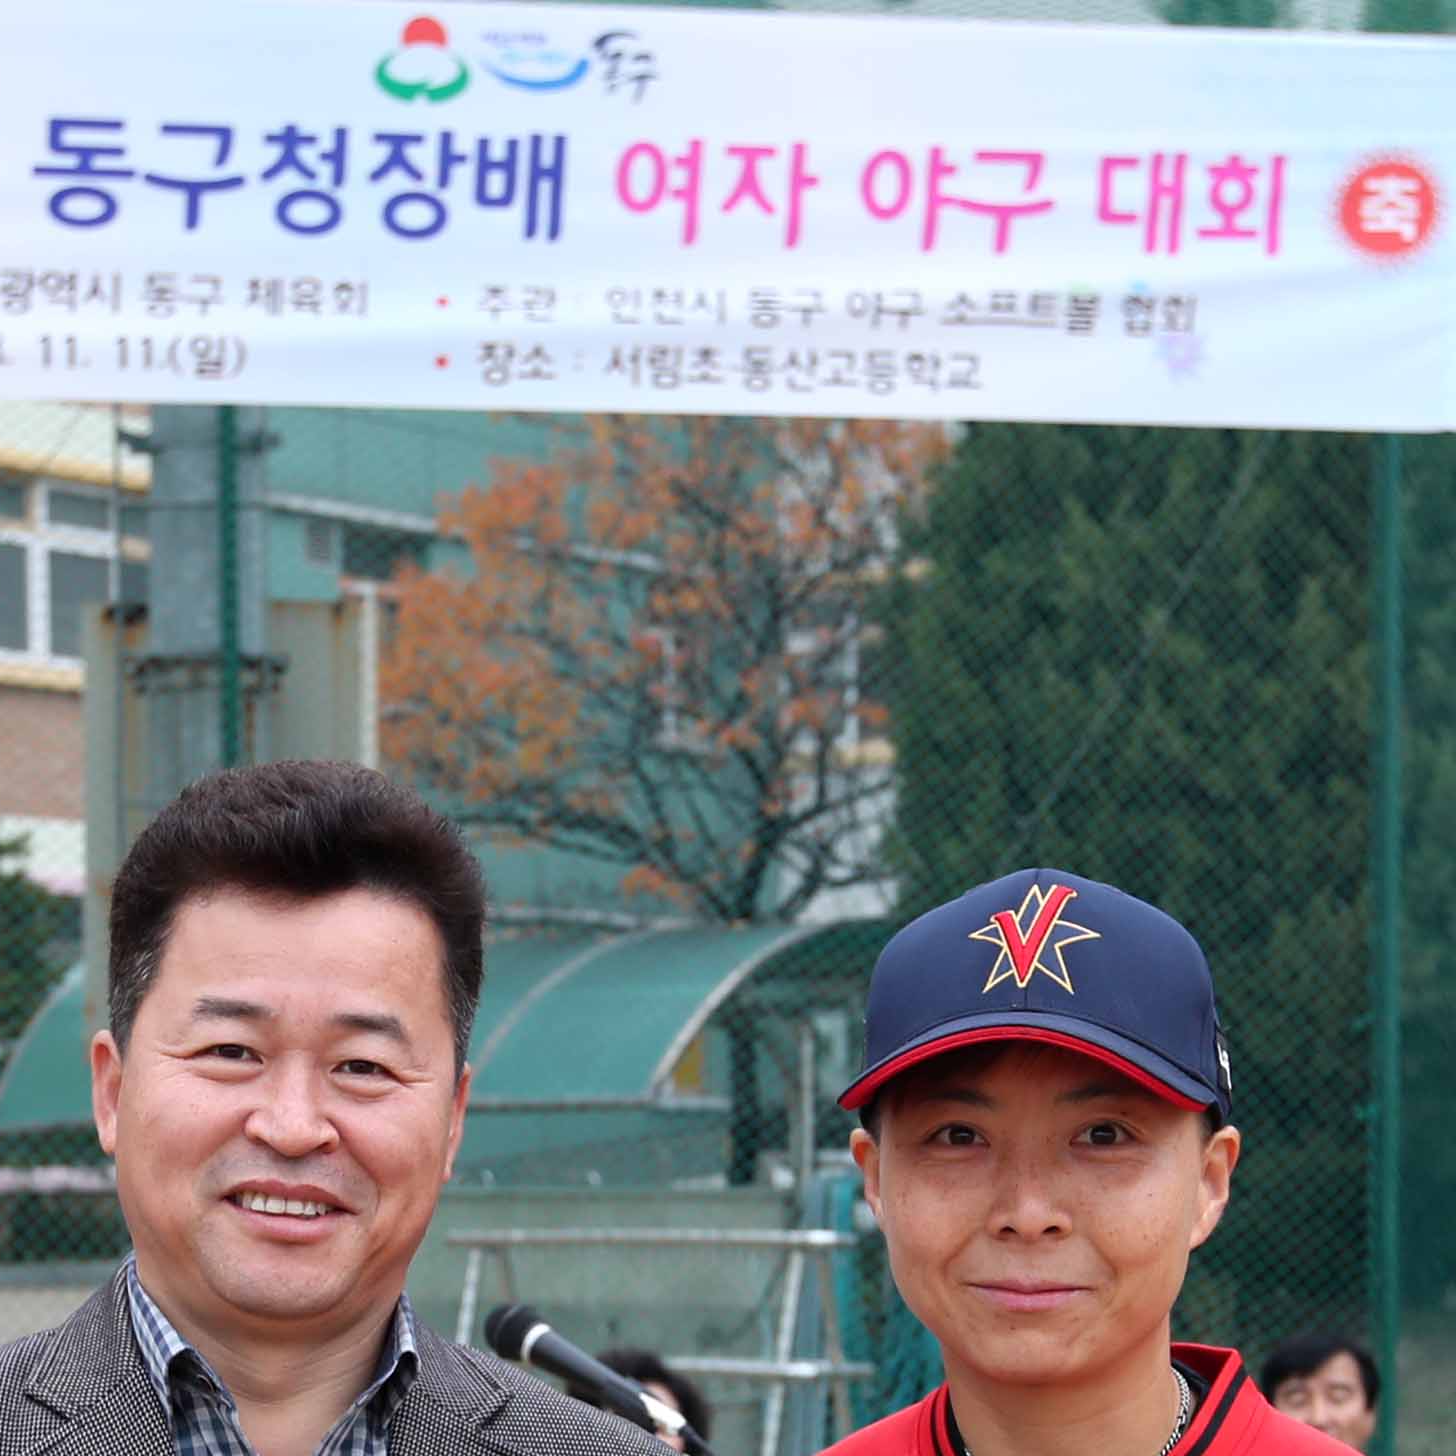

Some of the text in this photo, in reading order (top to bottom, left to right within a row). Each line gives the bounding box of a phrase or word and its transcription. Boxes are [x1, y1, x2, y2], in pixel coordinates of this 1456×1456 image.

[32, 116, 567, 242] 동구청장배
[614, 138, 821, 249] 여자
[859, 146, 1056, 255] 야구
[1097, 152, 1287, 256] 대회
[1357, 174, 1424, 244] 축
[141, 271, 225, 318] 동구
[245, 276, 369, 318] 체육회
[479, 284, 558, 324] 주관
[605, 286, 728, 326] 인천시
[748, 287, 826, 329] 동구
[846, 290, 926, 331] 야구
[939, 290, 1100, 336] 소프트볼
[479, 341, 558, 388] 장소
